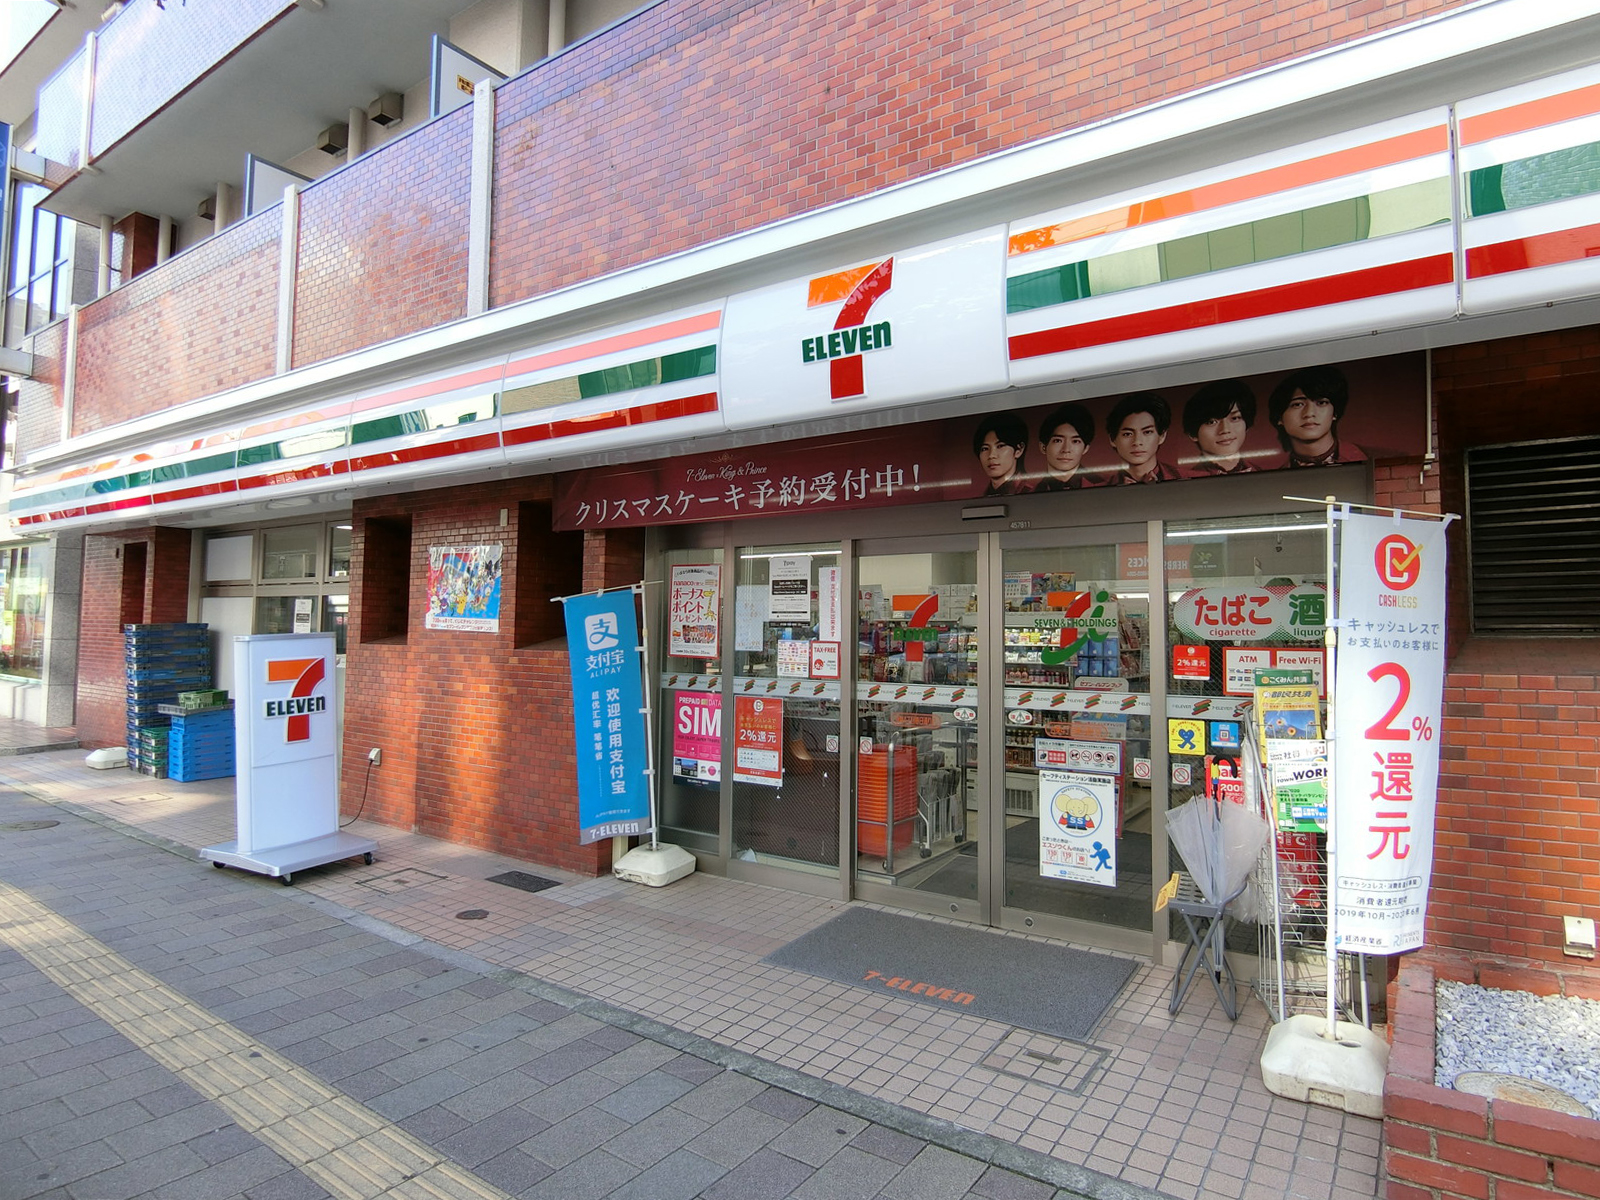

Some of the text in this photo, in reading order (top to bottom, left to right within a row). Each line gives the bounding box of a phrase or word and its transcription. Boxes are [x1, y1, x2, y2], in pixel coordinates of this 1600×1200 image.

[672, 587, 705, 600] ボーナス
[672, 601, 704, 614] ポイント
[1378, 594, 1418, 609] CASHLESS
[1194, 593, 1326, 626] たばこ 酒
[672, 614, 703, 623] プレゼント
[1073, 618, 1117, 628] HOLDINGS
[1209, 628, 1257, 637] cigarette
[1347, 618, 1440, 636] キャッシュレスで
[1347, 636, 1439, 651] お支払いのお客様に
[585, 650, 625, 672] 支付宝
[1278, 656, 1297, 665] Free
[1299, 656, 1322, 665] Wi-Fi
[590, 666, 622, 679] ALIPAY
[678, 696, 701, 705] PREPAID
[678, 705, 722, 737] SIM
[605, 687, 627, 795] 欢迎使用支付宝
[739, 729, 777, 743] 2%還元
